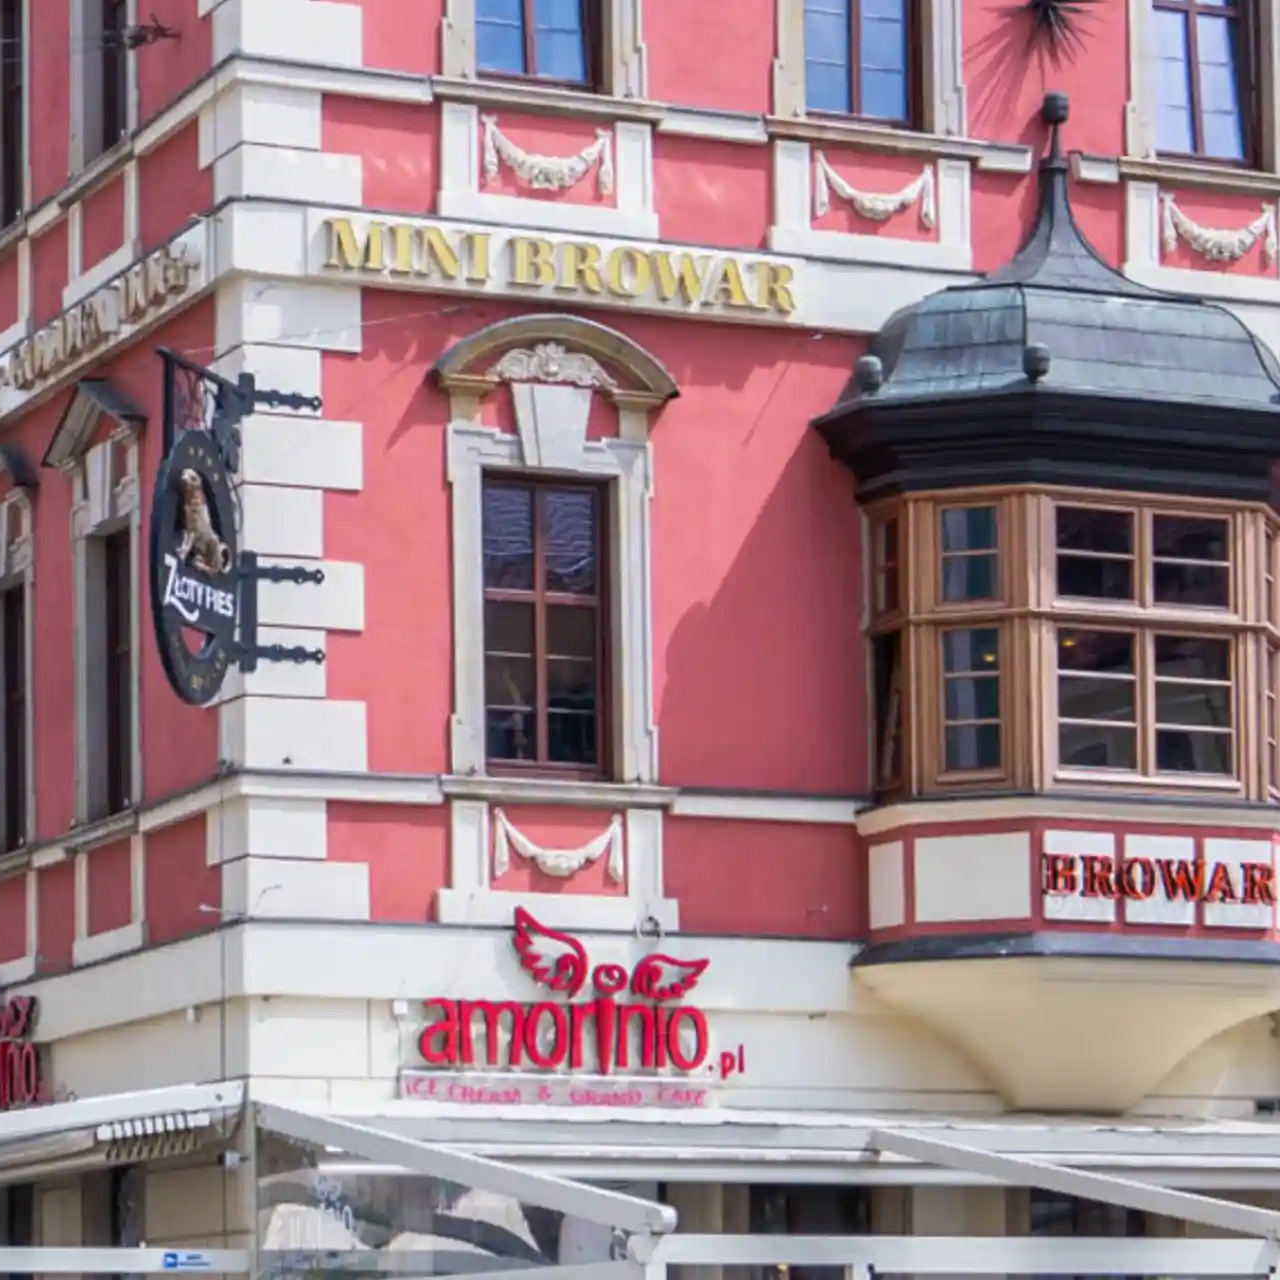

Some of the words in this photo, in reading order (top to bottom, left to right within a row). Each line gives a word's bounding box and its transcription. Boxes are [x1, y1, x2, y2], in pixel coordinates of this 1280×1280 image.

[324, 217, 491, 282] MINI
[507, 235, 796, 314] BROWAR
[1041, 852, 1277, 906] BROWAR
